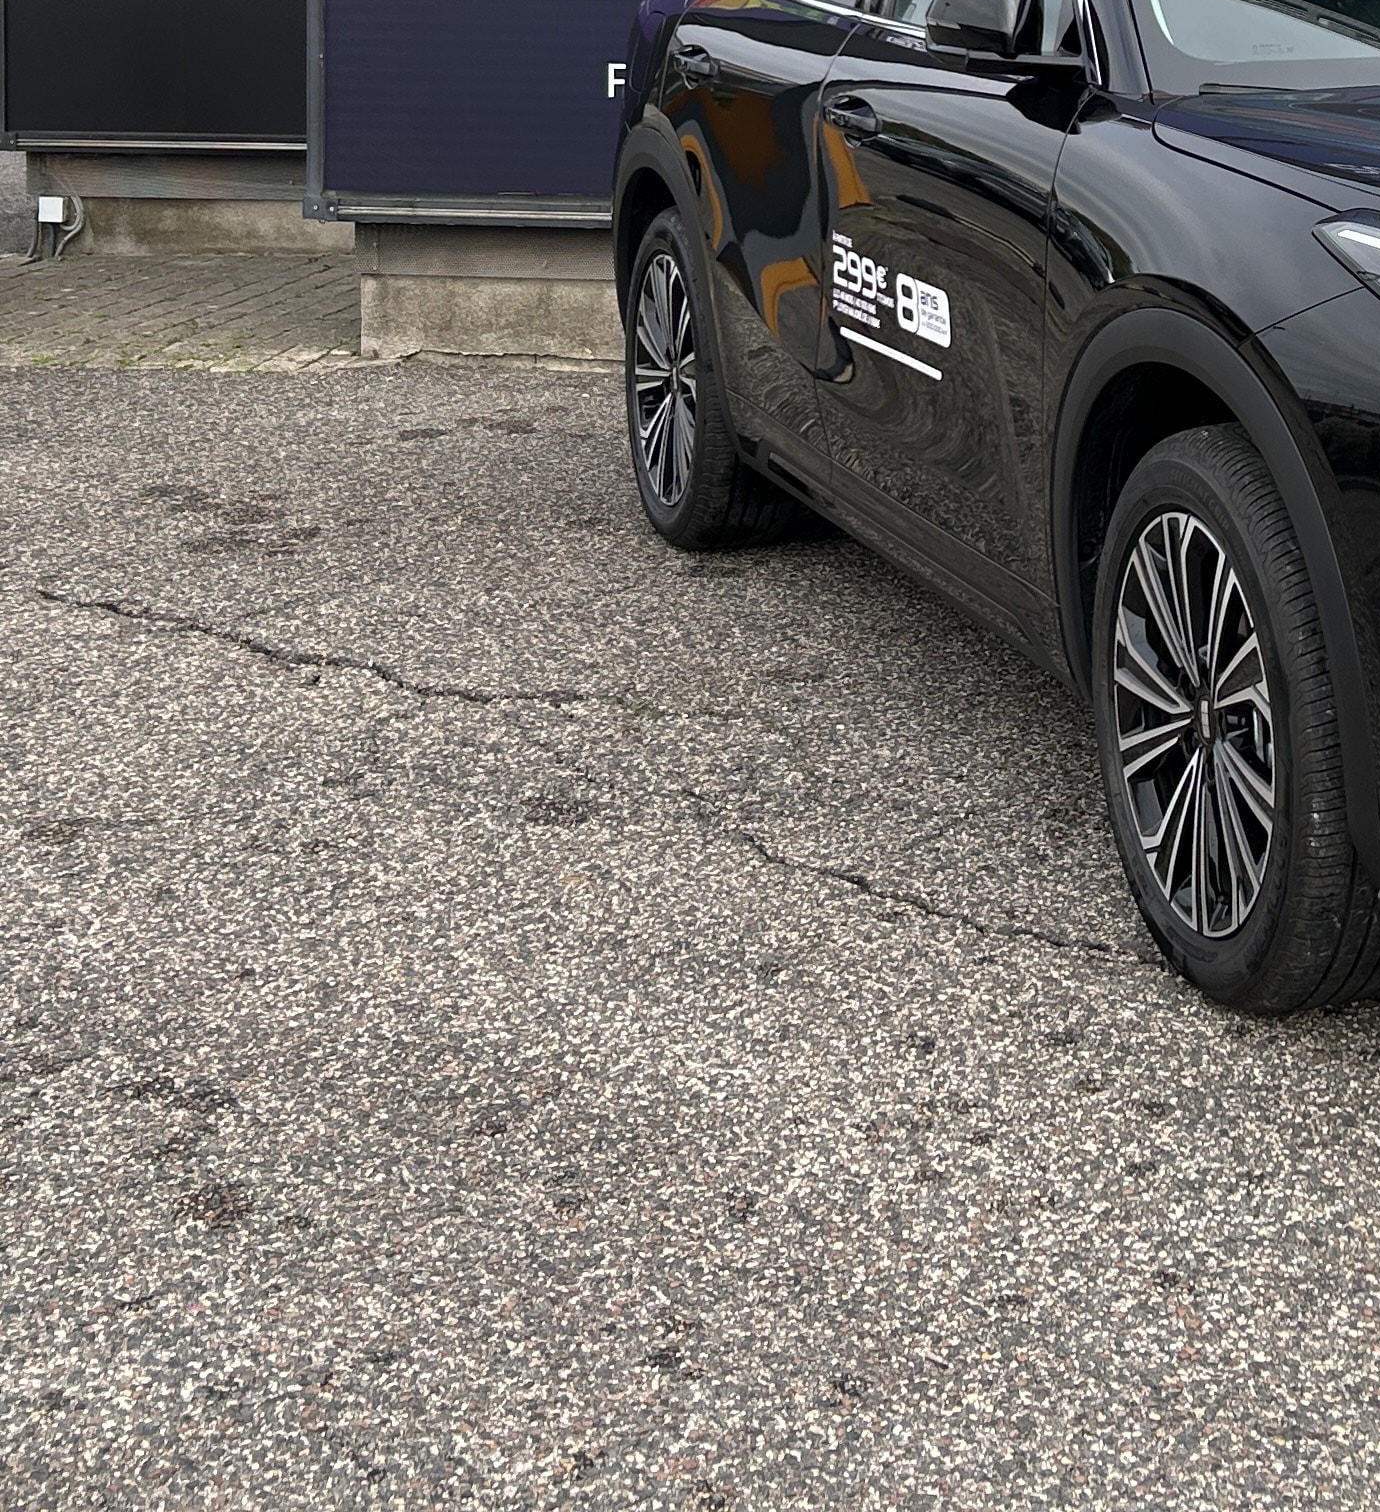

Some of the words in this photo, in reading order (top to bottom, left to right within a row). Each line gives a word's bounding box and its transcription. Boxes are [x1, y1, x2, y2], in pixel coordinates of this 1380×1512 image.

[607, 62, 627, 98] F
[896, 272, 919, 334] 8
[920, 290, 939, 311] ans
